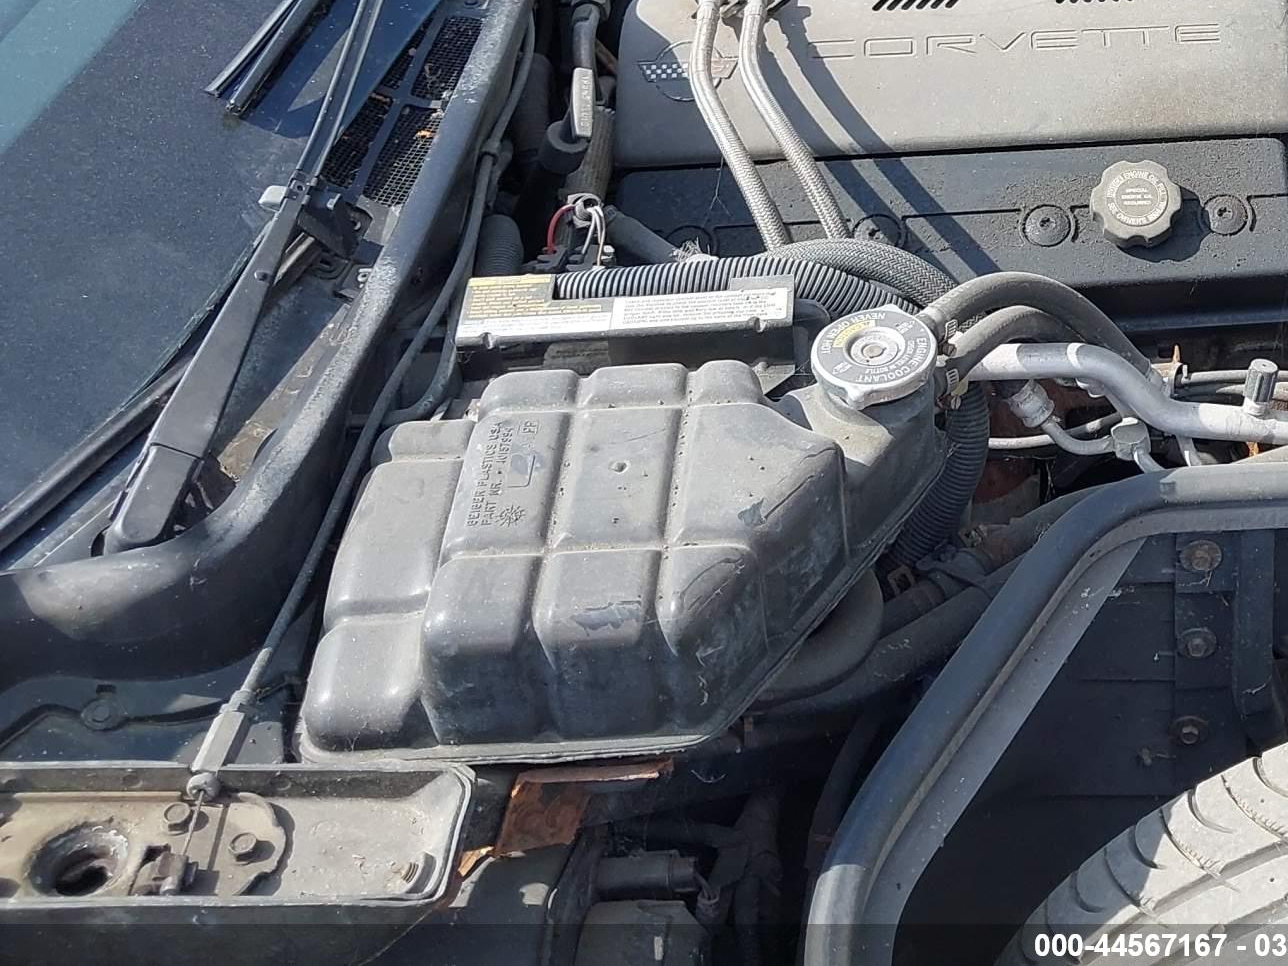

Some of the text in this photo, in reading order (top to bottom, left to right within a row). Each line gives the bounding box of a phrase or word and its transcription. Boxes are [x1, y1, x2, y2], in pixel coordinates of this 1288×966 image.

[807, 23, 1221, 59] CORVETTE
[821, 312, 886, 354] NEVER OPEN HOT
[908, 337, 927, 367] ENGINE
[856, 366, 910, 383] COOLANT
[477, 444, 497, 487] PLASTICS
[488, 422, 502, 441] USA
[481, 501, 497, 526] PART
